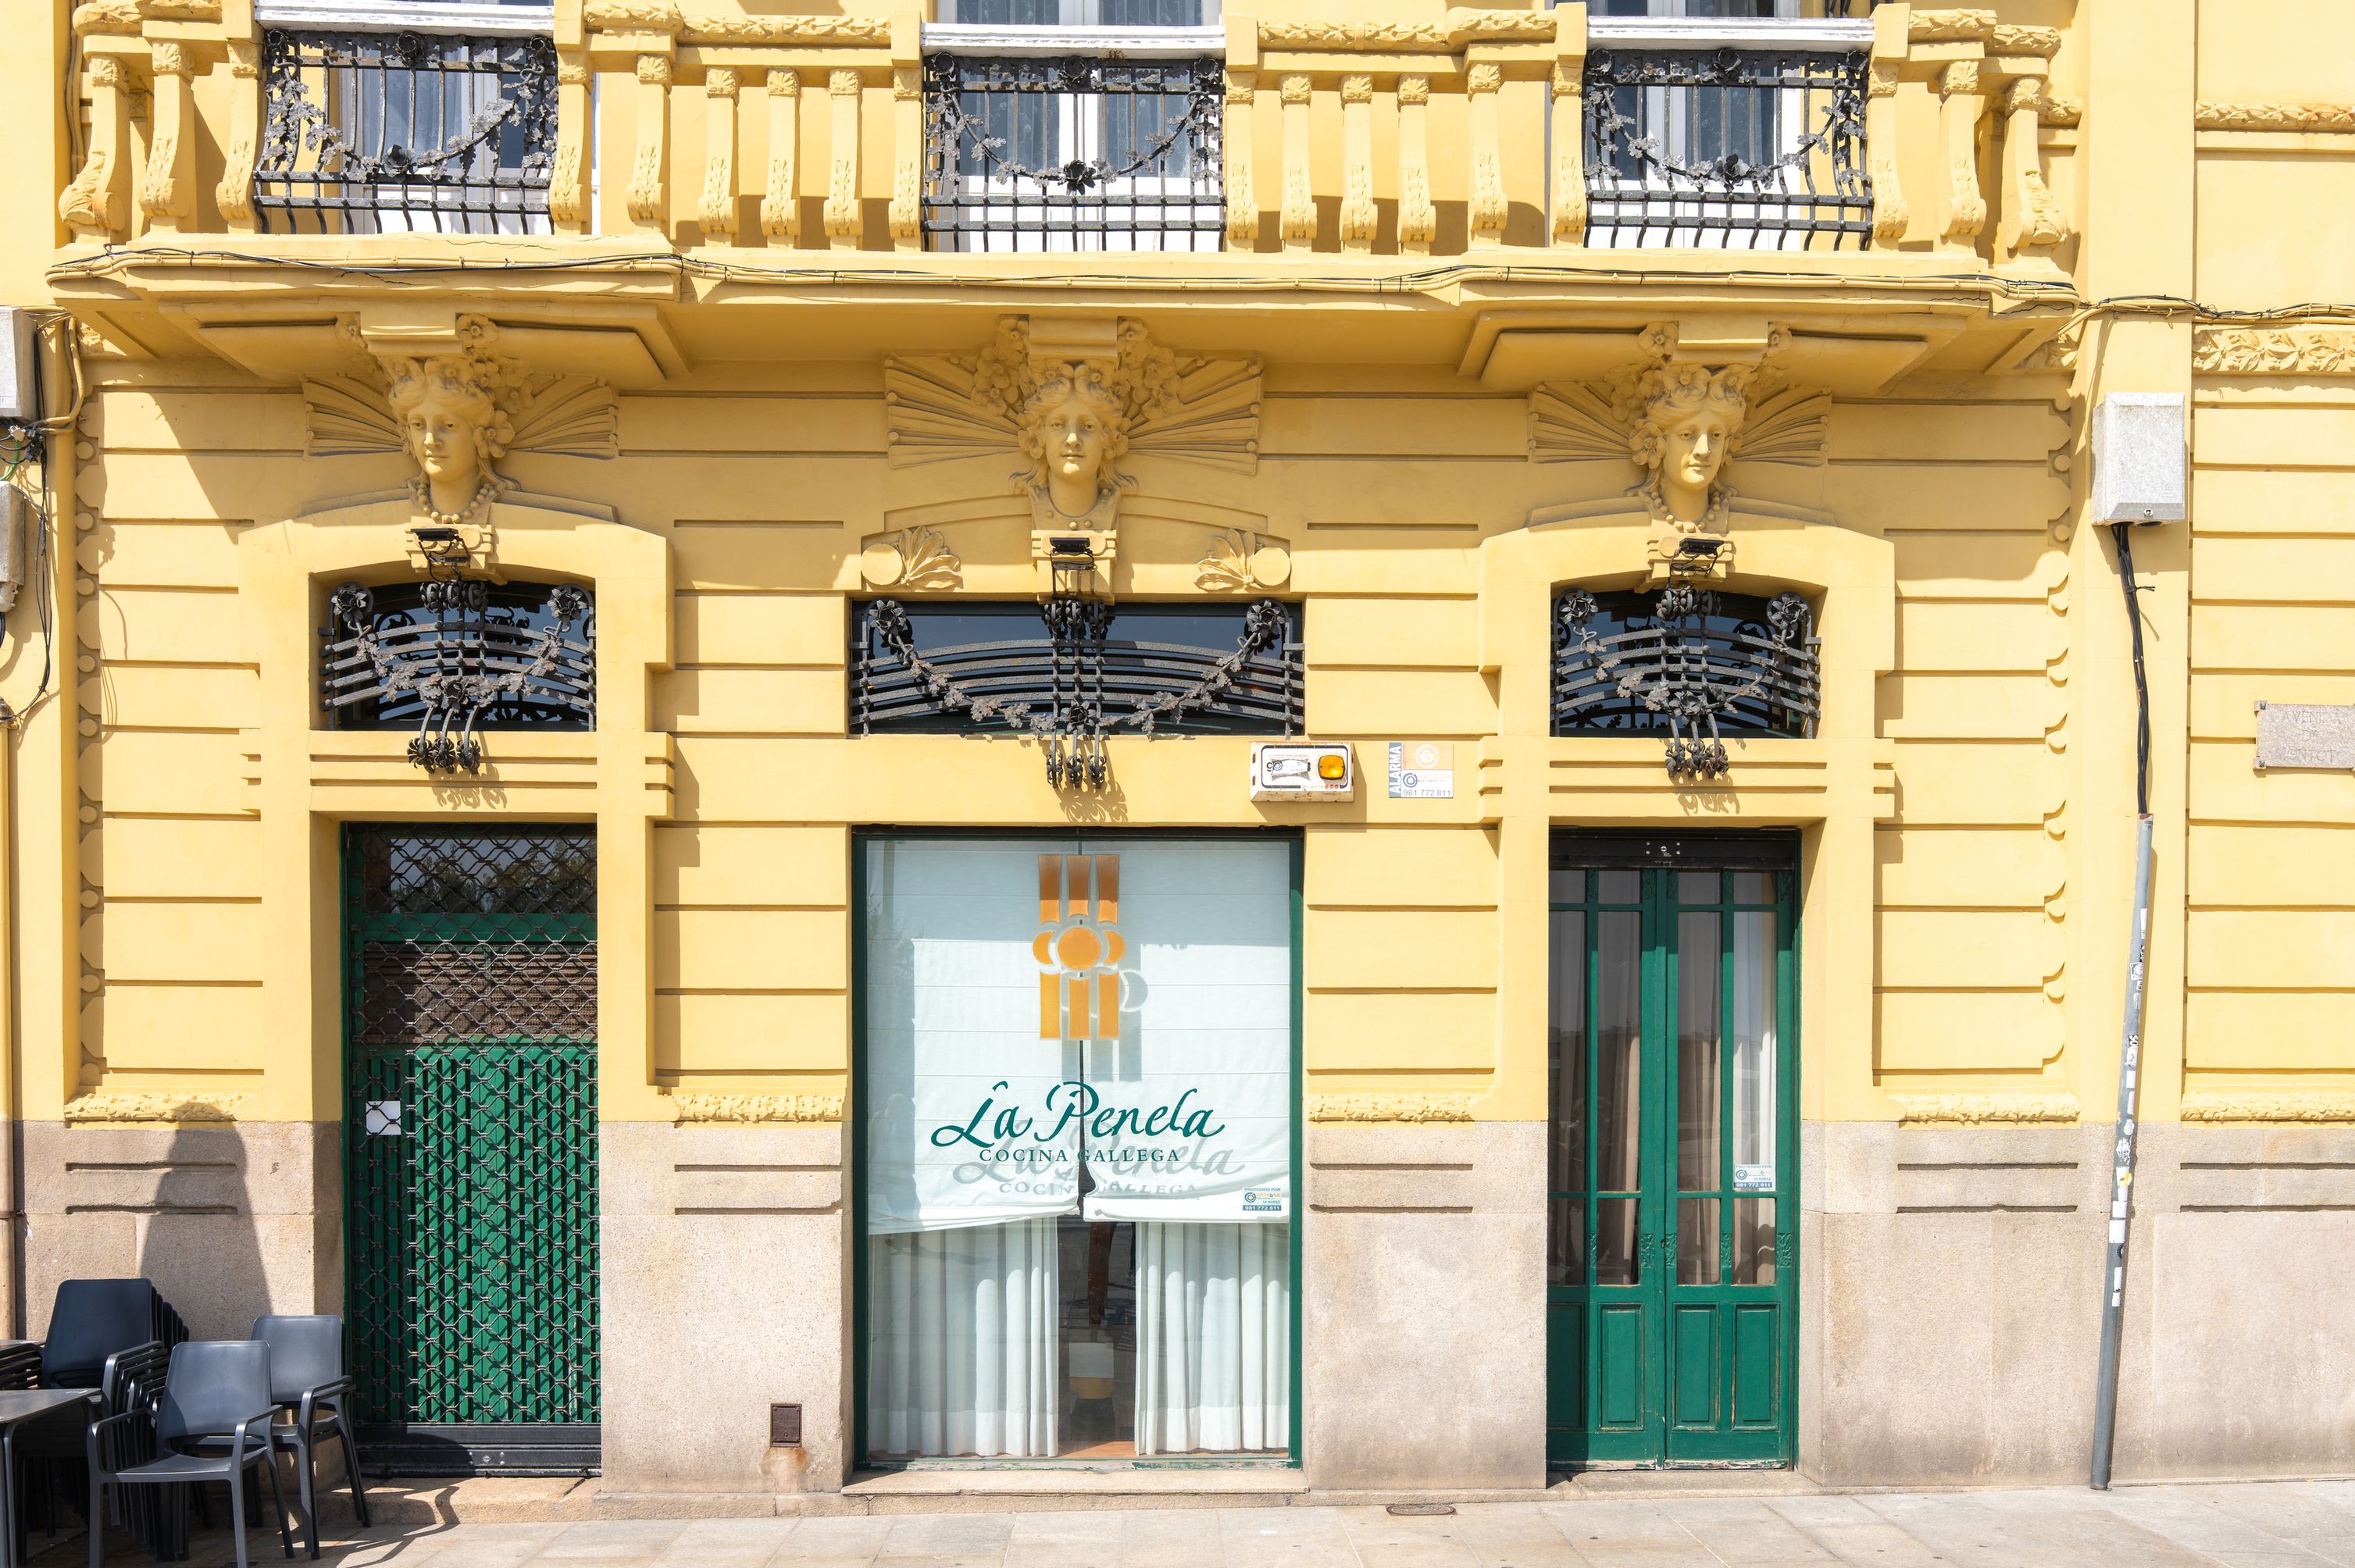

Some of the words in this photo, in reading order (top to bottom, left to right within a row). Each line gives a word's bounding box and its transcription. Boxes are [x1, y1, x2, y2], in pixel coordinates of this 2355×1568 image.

[1389, 745, 1401, 794] ALARMA
[930, 1080, 1033, 1149] La
[1033, 1081, 1226, 1142] Penela
[979, 1149, 1069, 1163] COCINA
[1077, 1149, 1181, 1163] GALLEGA
